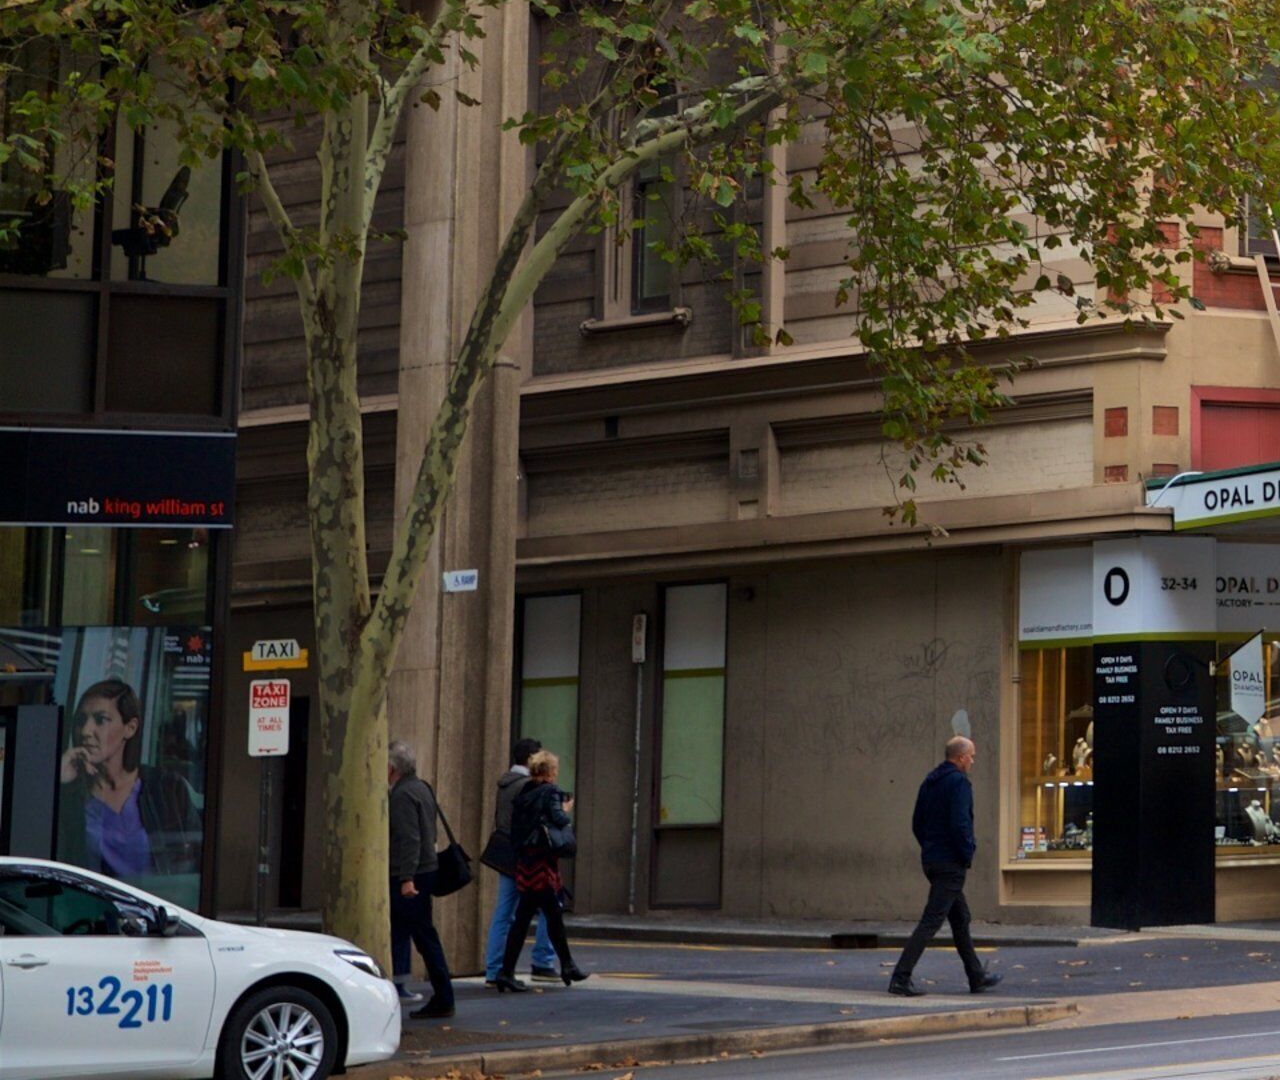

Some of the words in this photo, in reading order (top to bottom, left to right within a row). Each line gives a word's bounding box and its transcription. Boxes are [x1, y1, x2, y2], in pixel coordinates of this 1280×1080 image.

[1204, 486, 1254, 512] OPAL
[67, 497, 100, 514] nab
[103, 498, 141, 518] king
[146, 498, 205, 516] william
[210, 502, 225, 516] st
[1160, 577, 1198, 591] 32-34
[1215, 576, 1260, 594] OPAL
[257, 642, 294, 658] TAXI
[186, 654, 204, 664] nab
[1100, 656, 1116, 665] OPEN
[1119, 655, 1133, 664] DAYS
[1095, 665, 1114, 674] FAMILY
[1114, 664, 1138, 674] BUSINESS
[1105, 676, 1115, 684] TAX
[1115, 675, 1129, 684] FREE
[1232, 670, 1263, 684] OPAL
[255, 685, 286, 696] TAXI
[1233, 684, 1264, 693] DIAMOND
[253, 696, 286, 708] ZONE
[1159, 706, 1178, 715] OPEN
[1182, 706, 1198, 715] DAYS
[269, 716, 284, 724] ALL
[1154, 716, 1175, 724] FAMILY
[1176, 715, 1203, 724] BUSINESS
[257, 723, 283, 732] TIMES
[1165, 726, 1177, 735] TAX
[1177, 726, 1193, 734] FREE
[1157, 746, 1167, 754] 08
[1167, 746, 1183, 754] 8212
